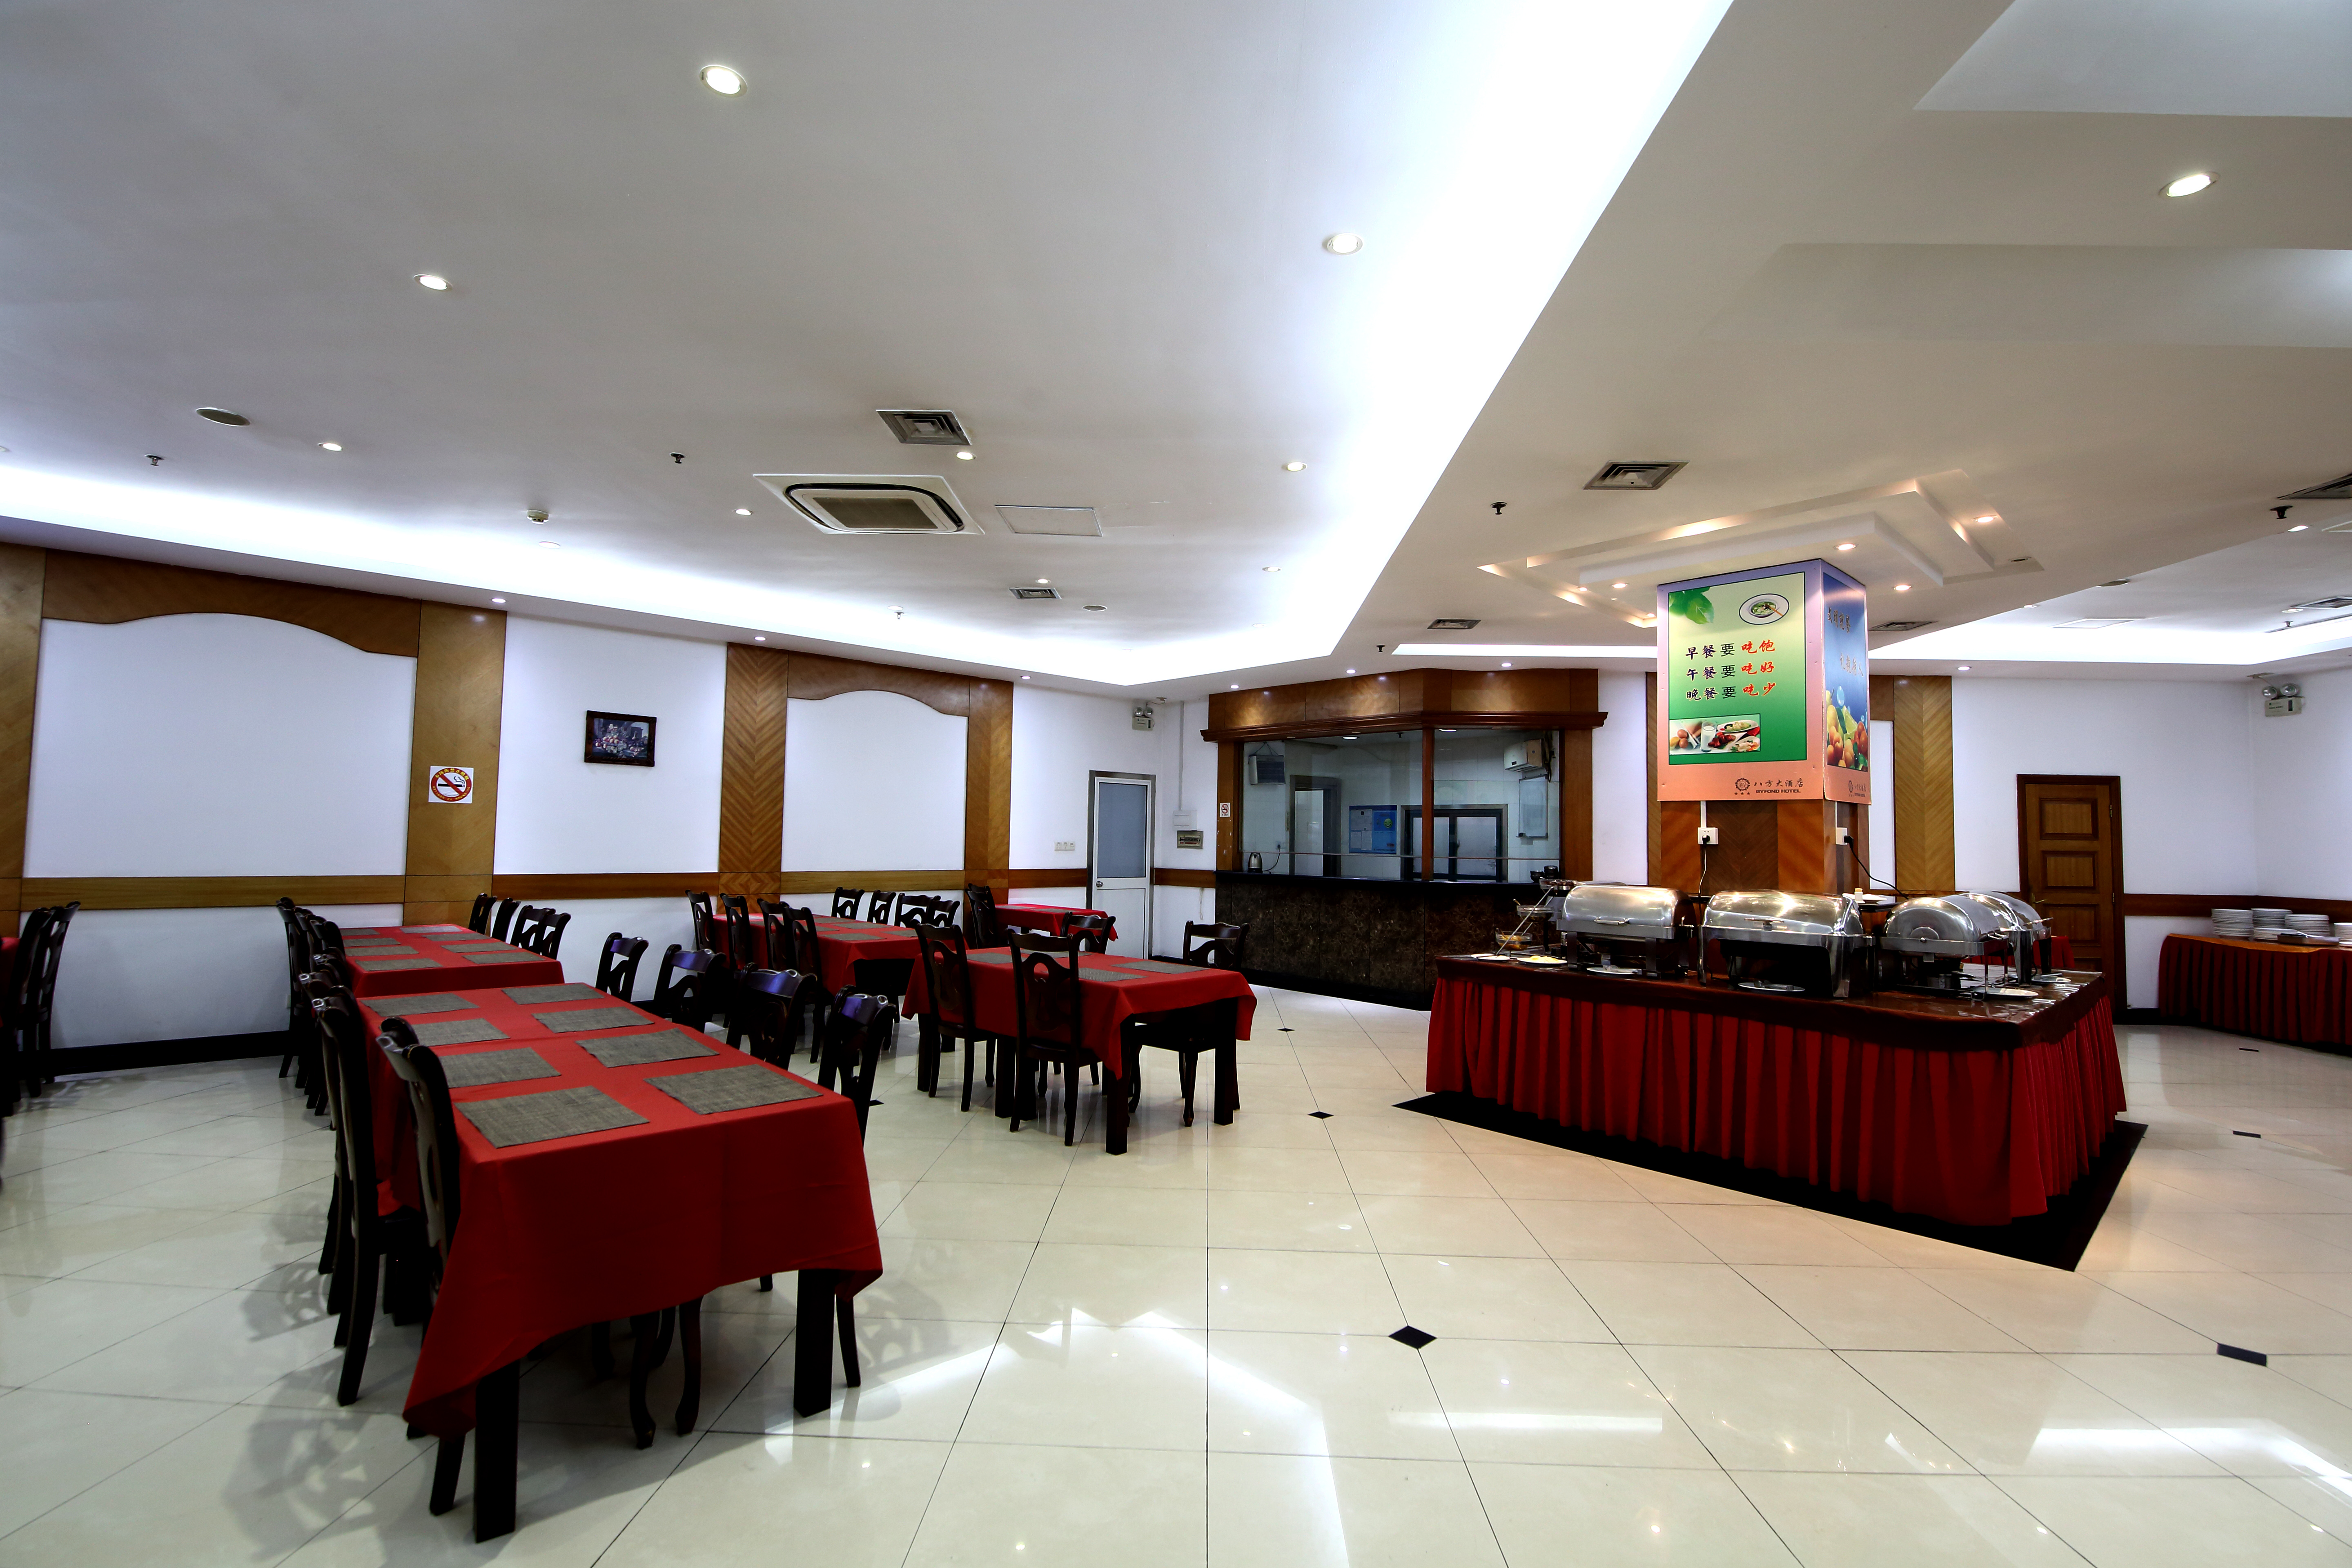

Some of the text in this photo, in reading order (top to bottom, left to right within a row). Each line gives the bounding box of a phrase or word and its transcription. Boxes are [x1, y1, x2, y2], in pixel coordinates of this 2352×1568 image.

[1685, 639, 1775, 660] 早餐要吃饱
[1686, 662, 1774, 681] 午餐要吃好
[1686, 683, 1776, 701] 晚餐要吃少
[1754, 778, 1803, 788] 八方大酒店
